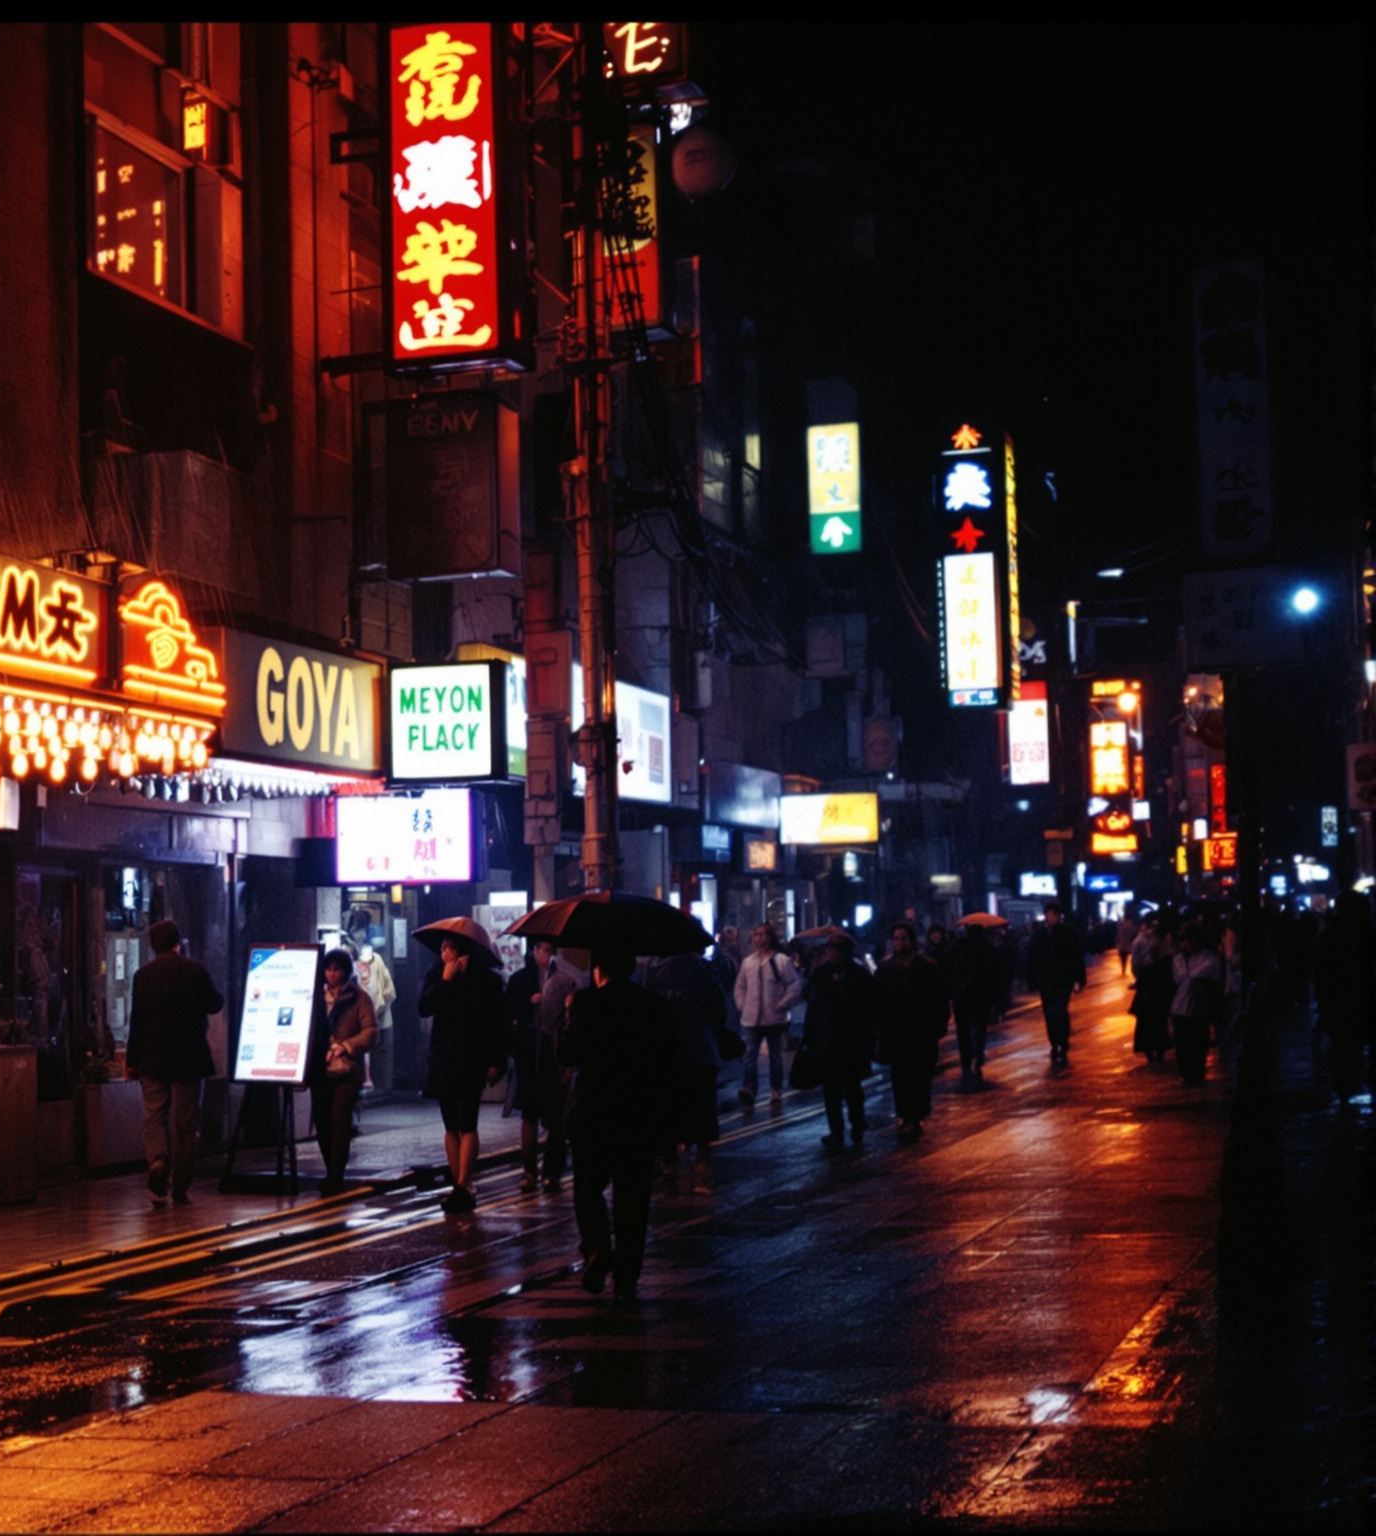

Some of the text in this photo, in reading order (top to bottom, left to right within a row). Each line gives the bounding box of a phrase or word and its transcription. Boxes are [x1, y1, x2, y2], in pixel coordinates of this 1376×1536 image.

[258, 647, 359, 761] GOYA
[401, 685, 483, 714] MEYON
[409, 724, 480, 751] FLACY
